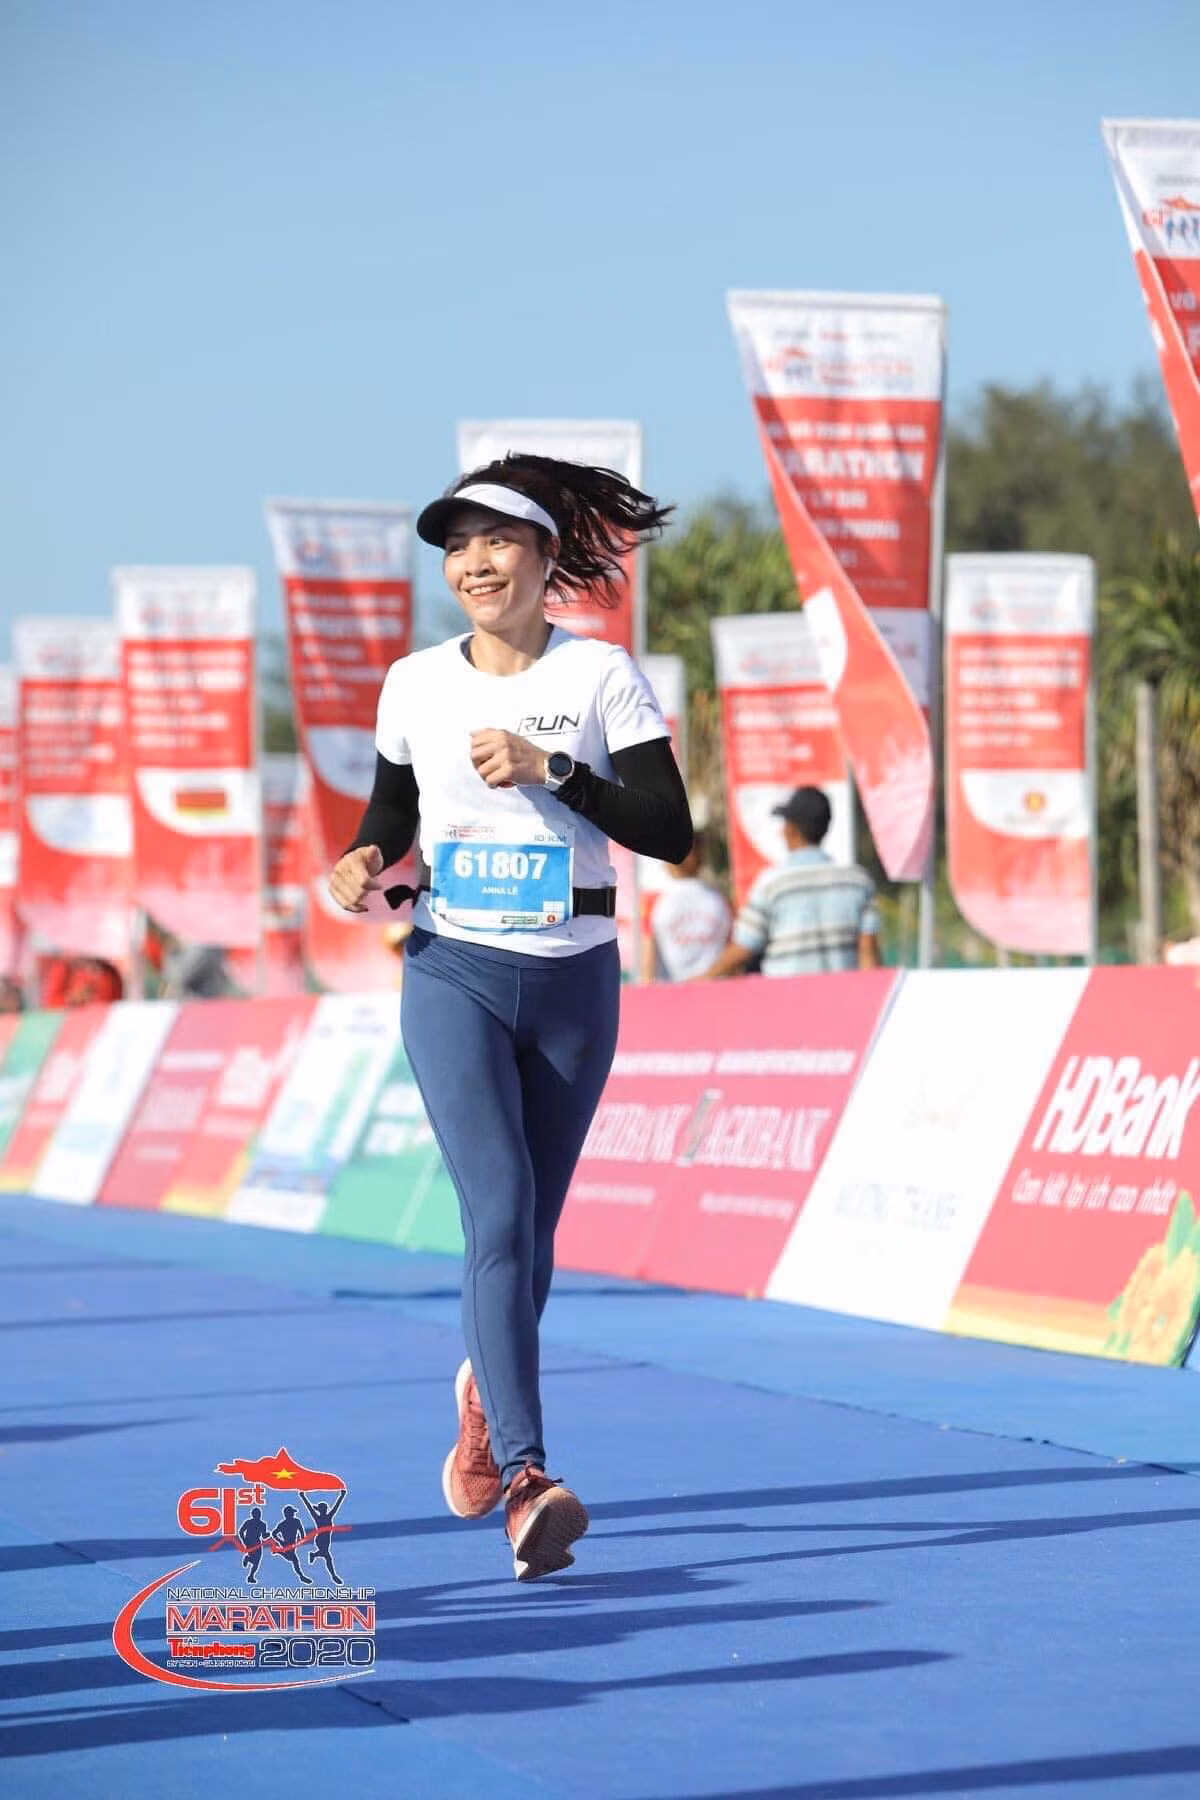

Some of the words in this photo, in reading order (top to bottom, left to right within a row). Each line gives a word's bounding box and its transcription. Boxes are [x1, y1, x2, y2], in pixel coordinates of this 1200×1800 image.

[516, 710, 581, 733] RUN
[453, 849, 548, 881] 61807
[1032, 1055, 1200, 1160] HDBank
